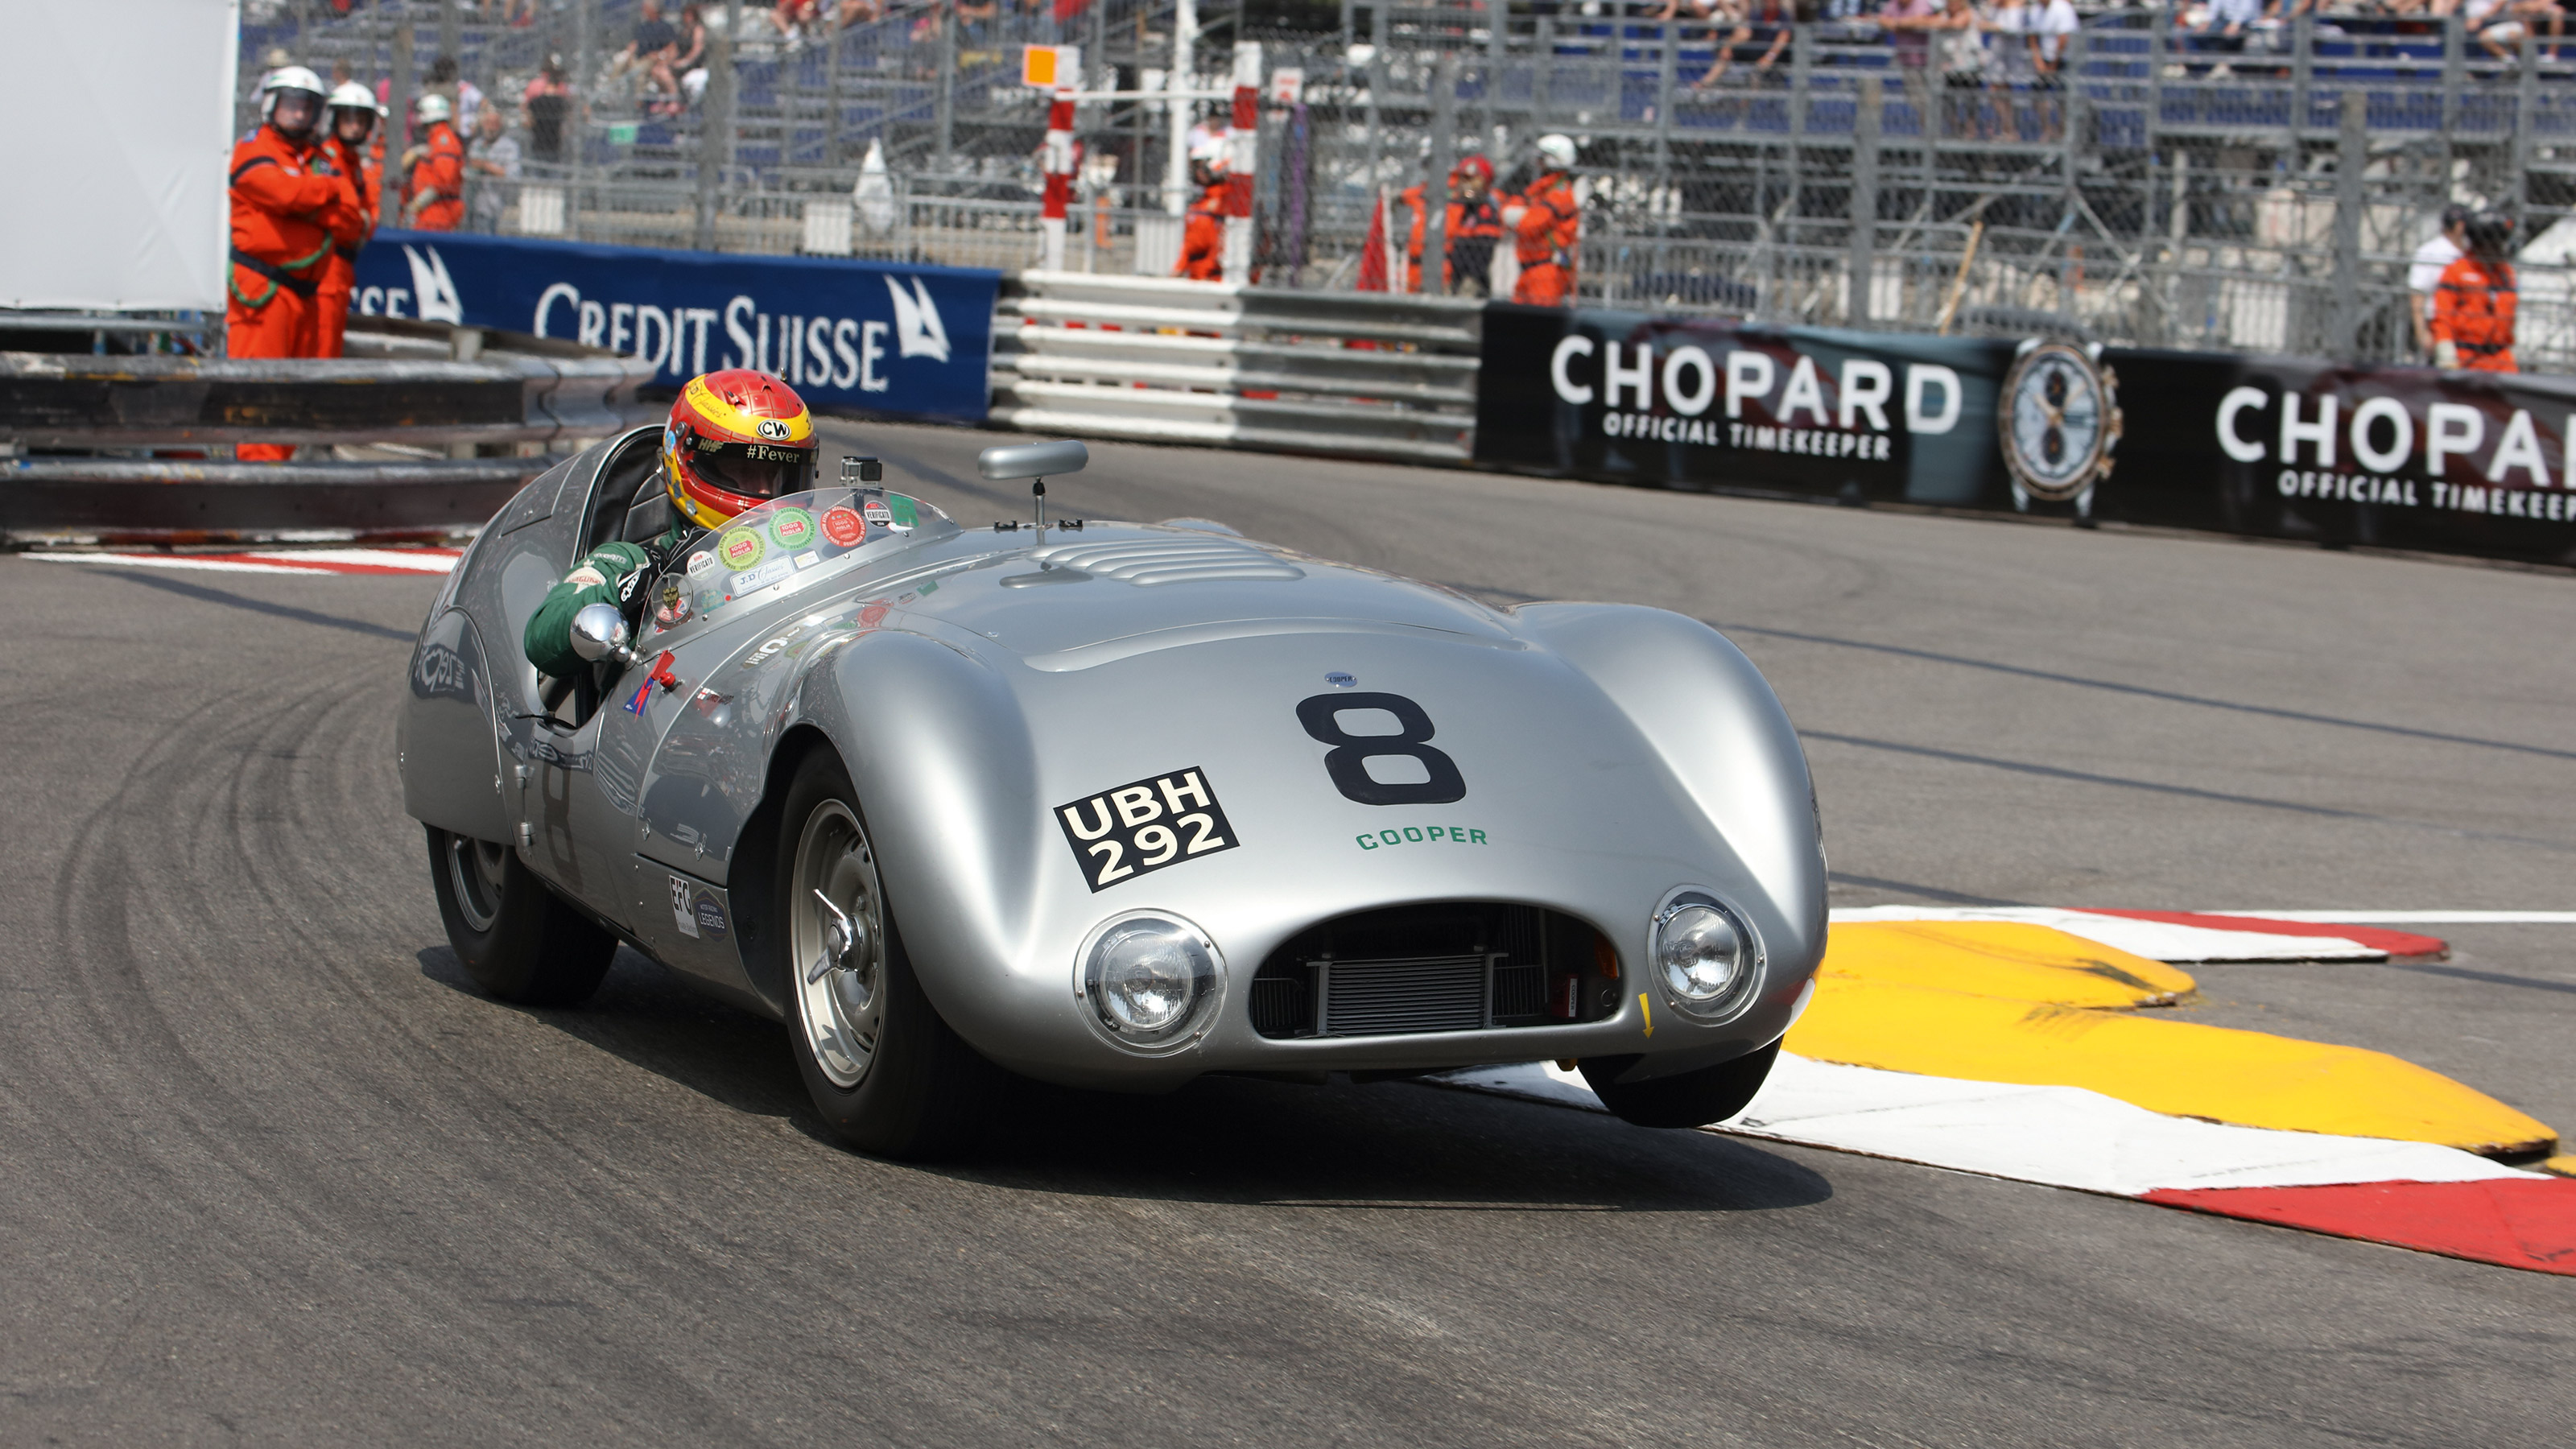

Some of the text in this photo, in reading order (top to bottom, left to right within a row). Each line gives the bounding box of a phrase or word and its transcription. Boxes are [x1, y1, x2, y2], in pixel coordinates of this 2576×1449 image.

[534, 283, 889, 392] CREDIT SUISSE
[1551, 335, 1962, 435] CHOPARD
[762, 422, 786, 436] CW
[1603, 412, 1892, 460] OFFICIAL TIMEKEEPER
[2215, 386, 2576, 489] CHOPA
[747, 444, 799, 463] #Fever
[2278, 470, 2418, 506] OFFICIAL
[731, 543, 747, 551] 1000
[1295, 691, 1466, 806] 8
[1063, 772, 1211, 841] UBH
[1088, 813, 1225, 886] 292
[1356, 826, 1488, 850] COOPER
[698, 911, 724, 929] LEGENDS
